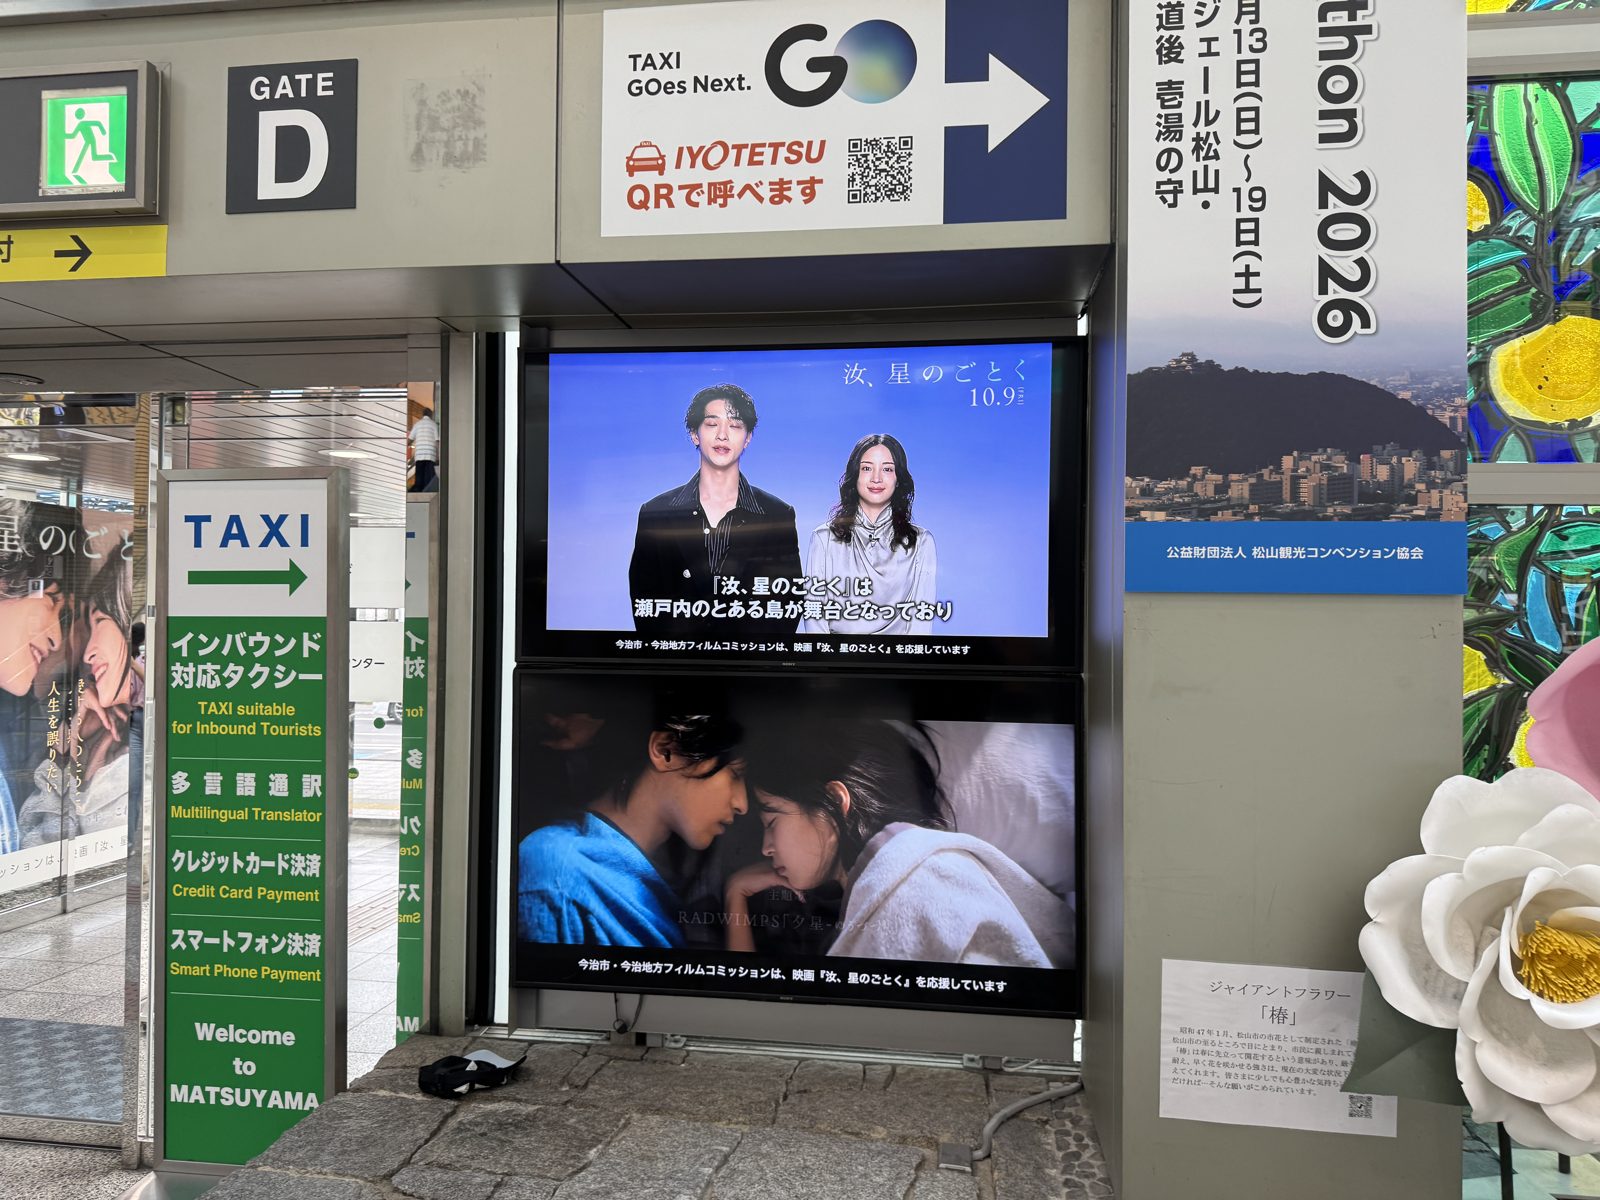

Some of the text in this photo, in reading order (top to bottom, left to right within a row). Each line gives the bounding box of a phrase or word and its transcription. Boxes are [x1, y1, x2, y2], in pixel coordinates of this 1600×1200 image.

[1156, 0, 1185, 66] 道後
[628, 51, 681, 72] TAXI
[764, 18, 918, 108] GO
[250, 72, 335, 101] GATE
[627, 73, 752, 97] GOes Next.
[257, 108, 330, 200] D
[674, 138, 827, 171] IYOTETSU
[626, 176, 824, 211] QRで呼べます
[1317, 168, 1372, 339] 2026
[843, 359, 1025, 388] 汝、星のごとく
[970, 386, 1016, 407] 10.9
[184, 513, 310, 549] TAXI
[1166, 546, 1425, 560] 公益財団法人 松山観光コンベンション協会
[713, 576, 873, 598] 『汝、星のごとく』は
[634, 598, 953, 622] 瀬戸内のとある島が舞台となっており
[171, 631, 322, 658] インバウンド
[171, 661, 323, 689] 対応タクシー
[198, 701, 296, 716] TAXI suitable
[46, 680, 61, 793] 人生を誤りたい
[171, 720, 322, 737] for Inbound Tourists
[171, 770, 322, 798] 多言語通訳
[170, 805, 323, 823] Multilingual Translator
[171, 849, 321, 878] クレジットカード決済
[172, 883, 320, 903] Credit Card Payment
[171, 929, 321, 958] スマートフォン決済
[170, 962, 321, 983] Smart Phone Payment
[1210, 981, 1351, 1000] ジャイアントフラワー
[1260, 1005, 1296, 1026] 「椿」
[194, 1022, 296, 1046] Welcome
[233, 1057, 257, 1076] to
[170, 1084, 320, 1111] MATSUYAMA
